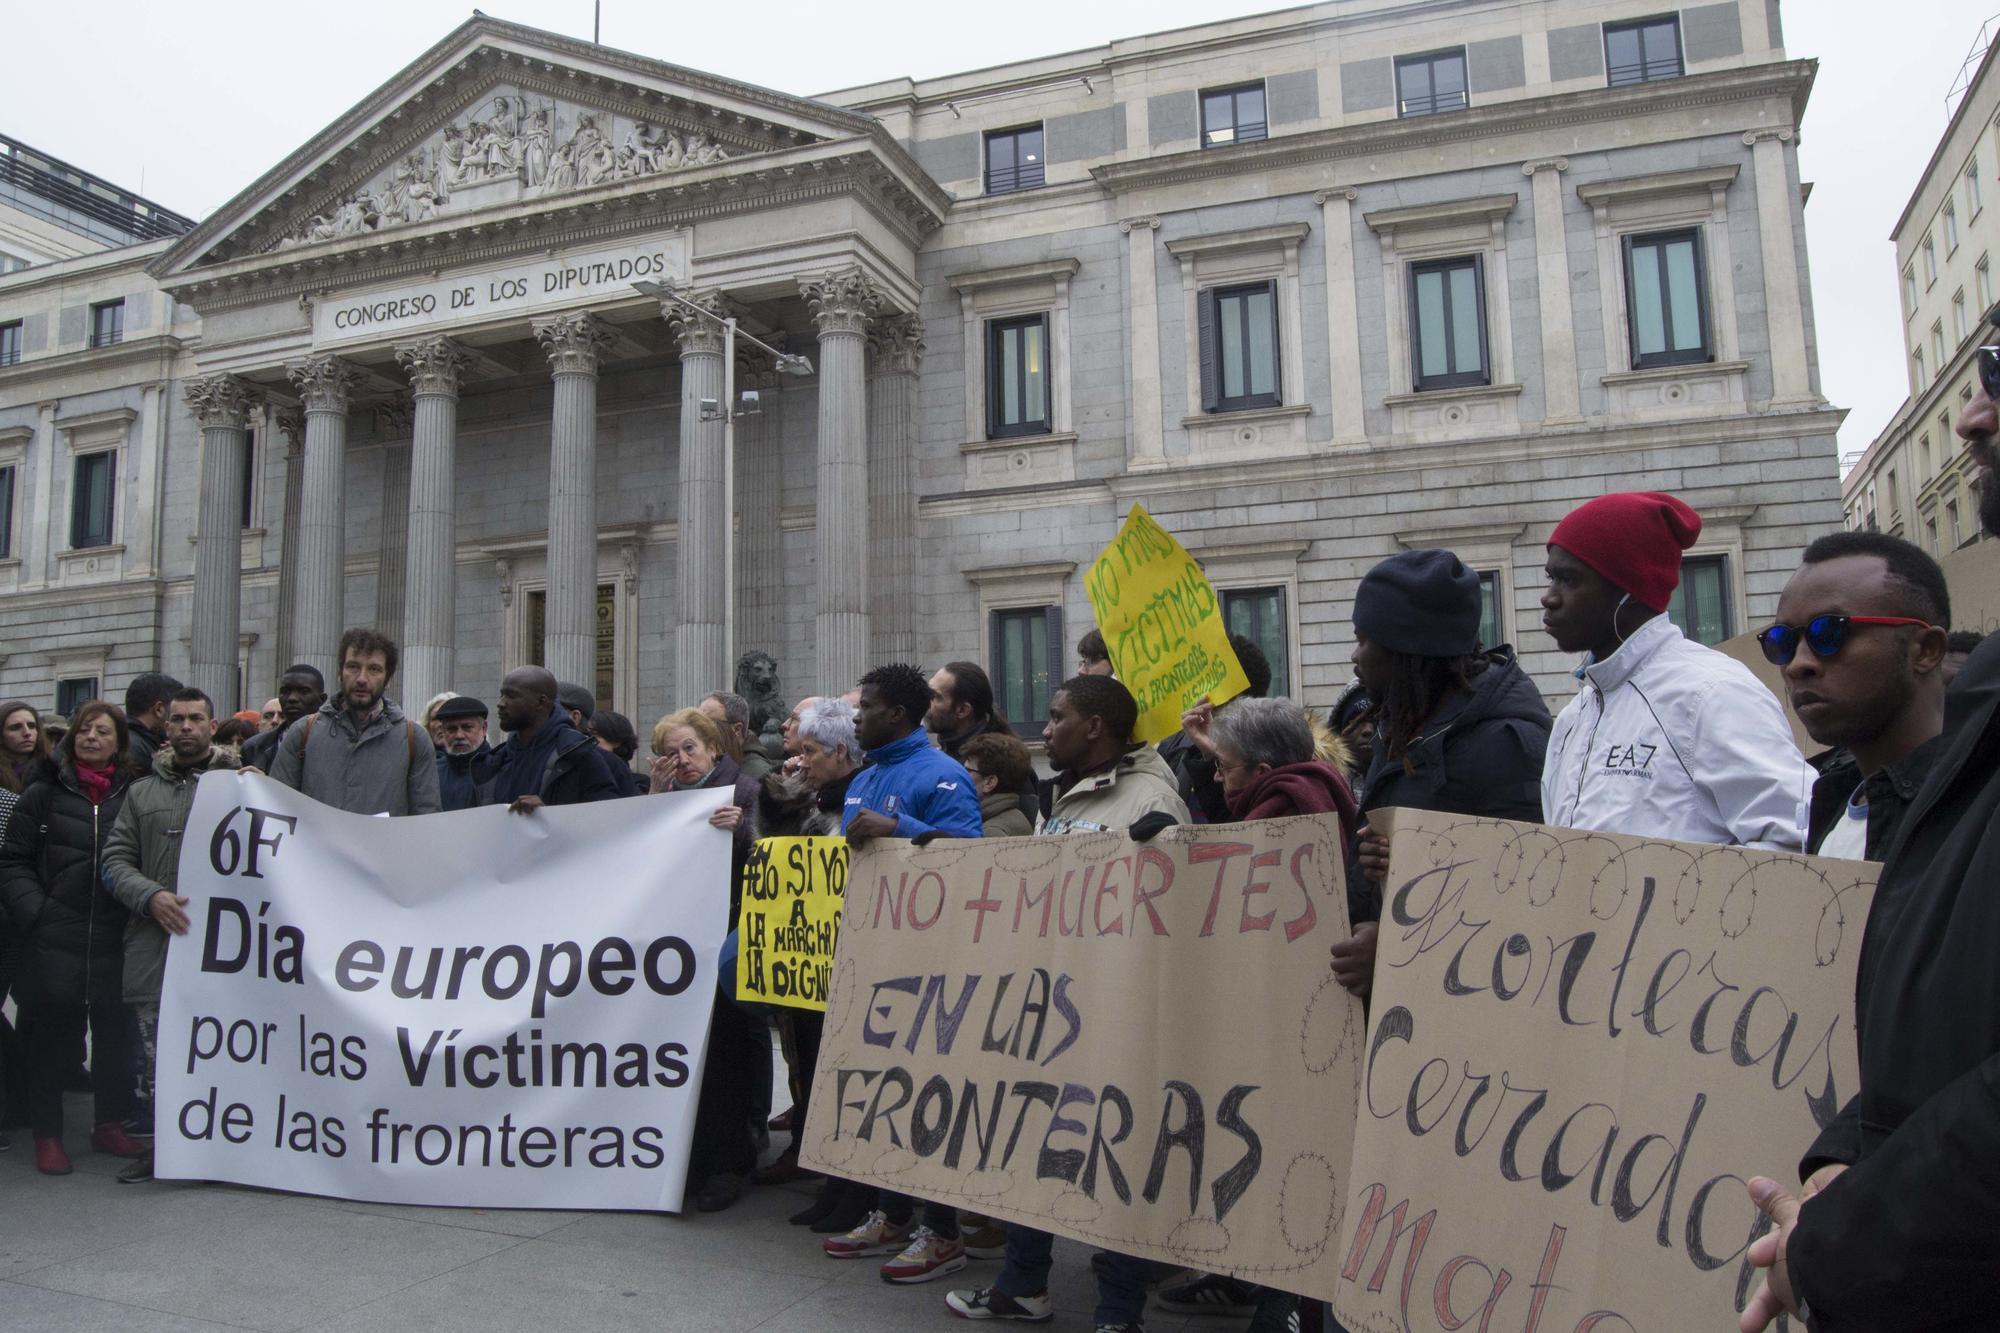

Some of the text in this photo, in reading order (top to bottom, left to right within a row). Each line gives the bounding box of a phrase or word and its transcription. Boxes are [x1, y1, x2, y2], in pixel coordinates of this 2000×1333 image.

[335, 253, 665, 330] CONGRESO DE LOS DIPUTADOS
[1090, 557, 1121, 629] NO
[1606, 743, 1658, 769] EA7
[210, 806, 297, 879] 6F
[746, 911, 767, 948] LA
[872, 870, 946, 932] NO
[1012, 841, 1320, 943] MUERTES
[201, 897, 697, 1018] Día europeo
[746, 949, 767, 996] LA
[187, 1013, 690, 1088] por las Víctimas
[862, 967, 1082, 1067] EN LAS
[178, 1087, 665, 1169] de las fronteras
[835, 1067, 1263, 1225] FRONTERAS
[1367, 1005, 1788, 1333] Cerrada
